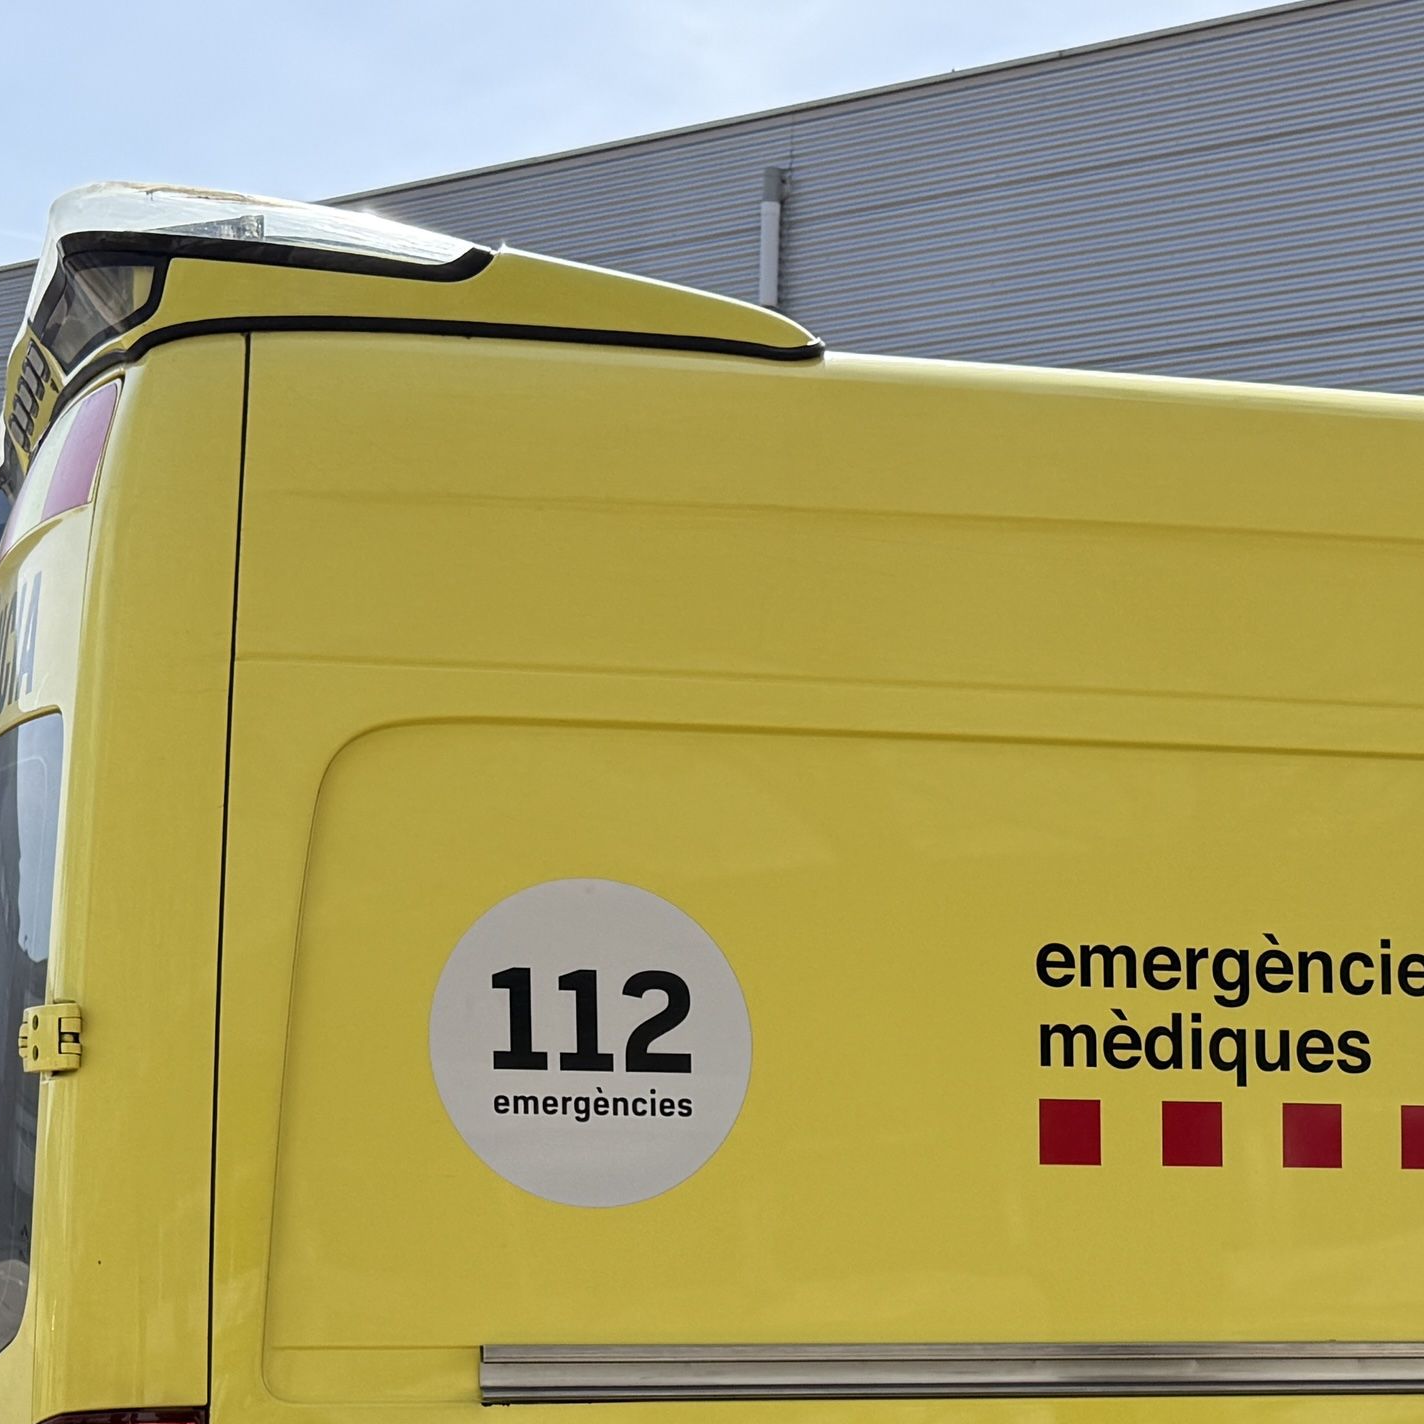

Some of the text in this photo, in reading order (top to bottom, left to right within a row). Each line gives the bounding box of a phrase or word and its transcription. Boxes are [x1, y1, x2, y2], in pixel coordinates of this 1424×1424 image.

[491, 967, 692, 1073] 112
[1039, 1008, 1372, 1087] mèdiques
[493, 1086, 693, 1122] emergències
